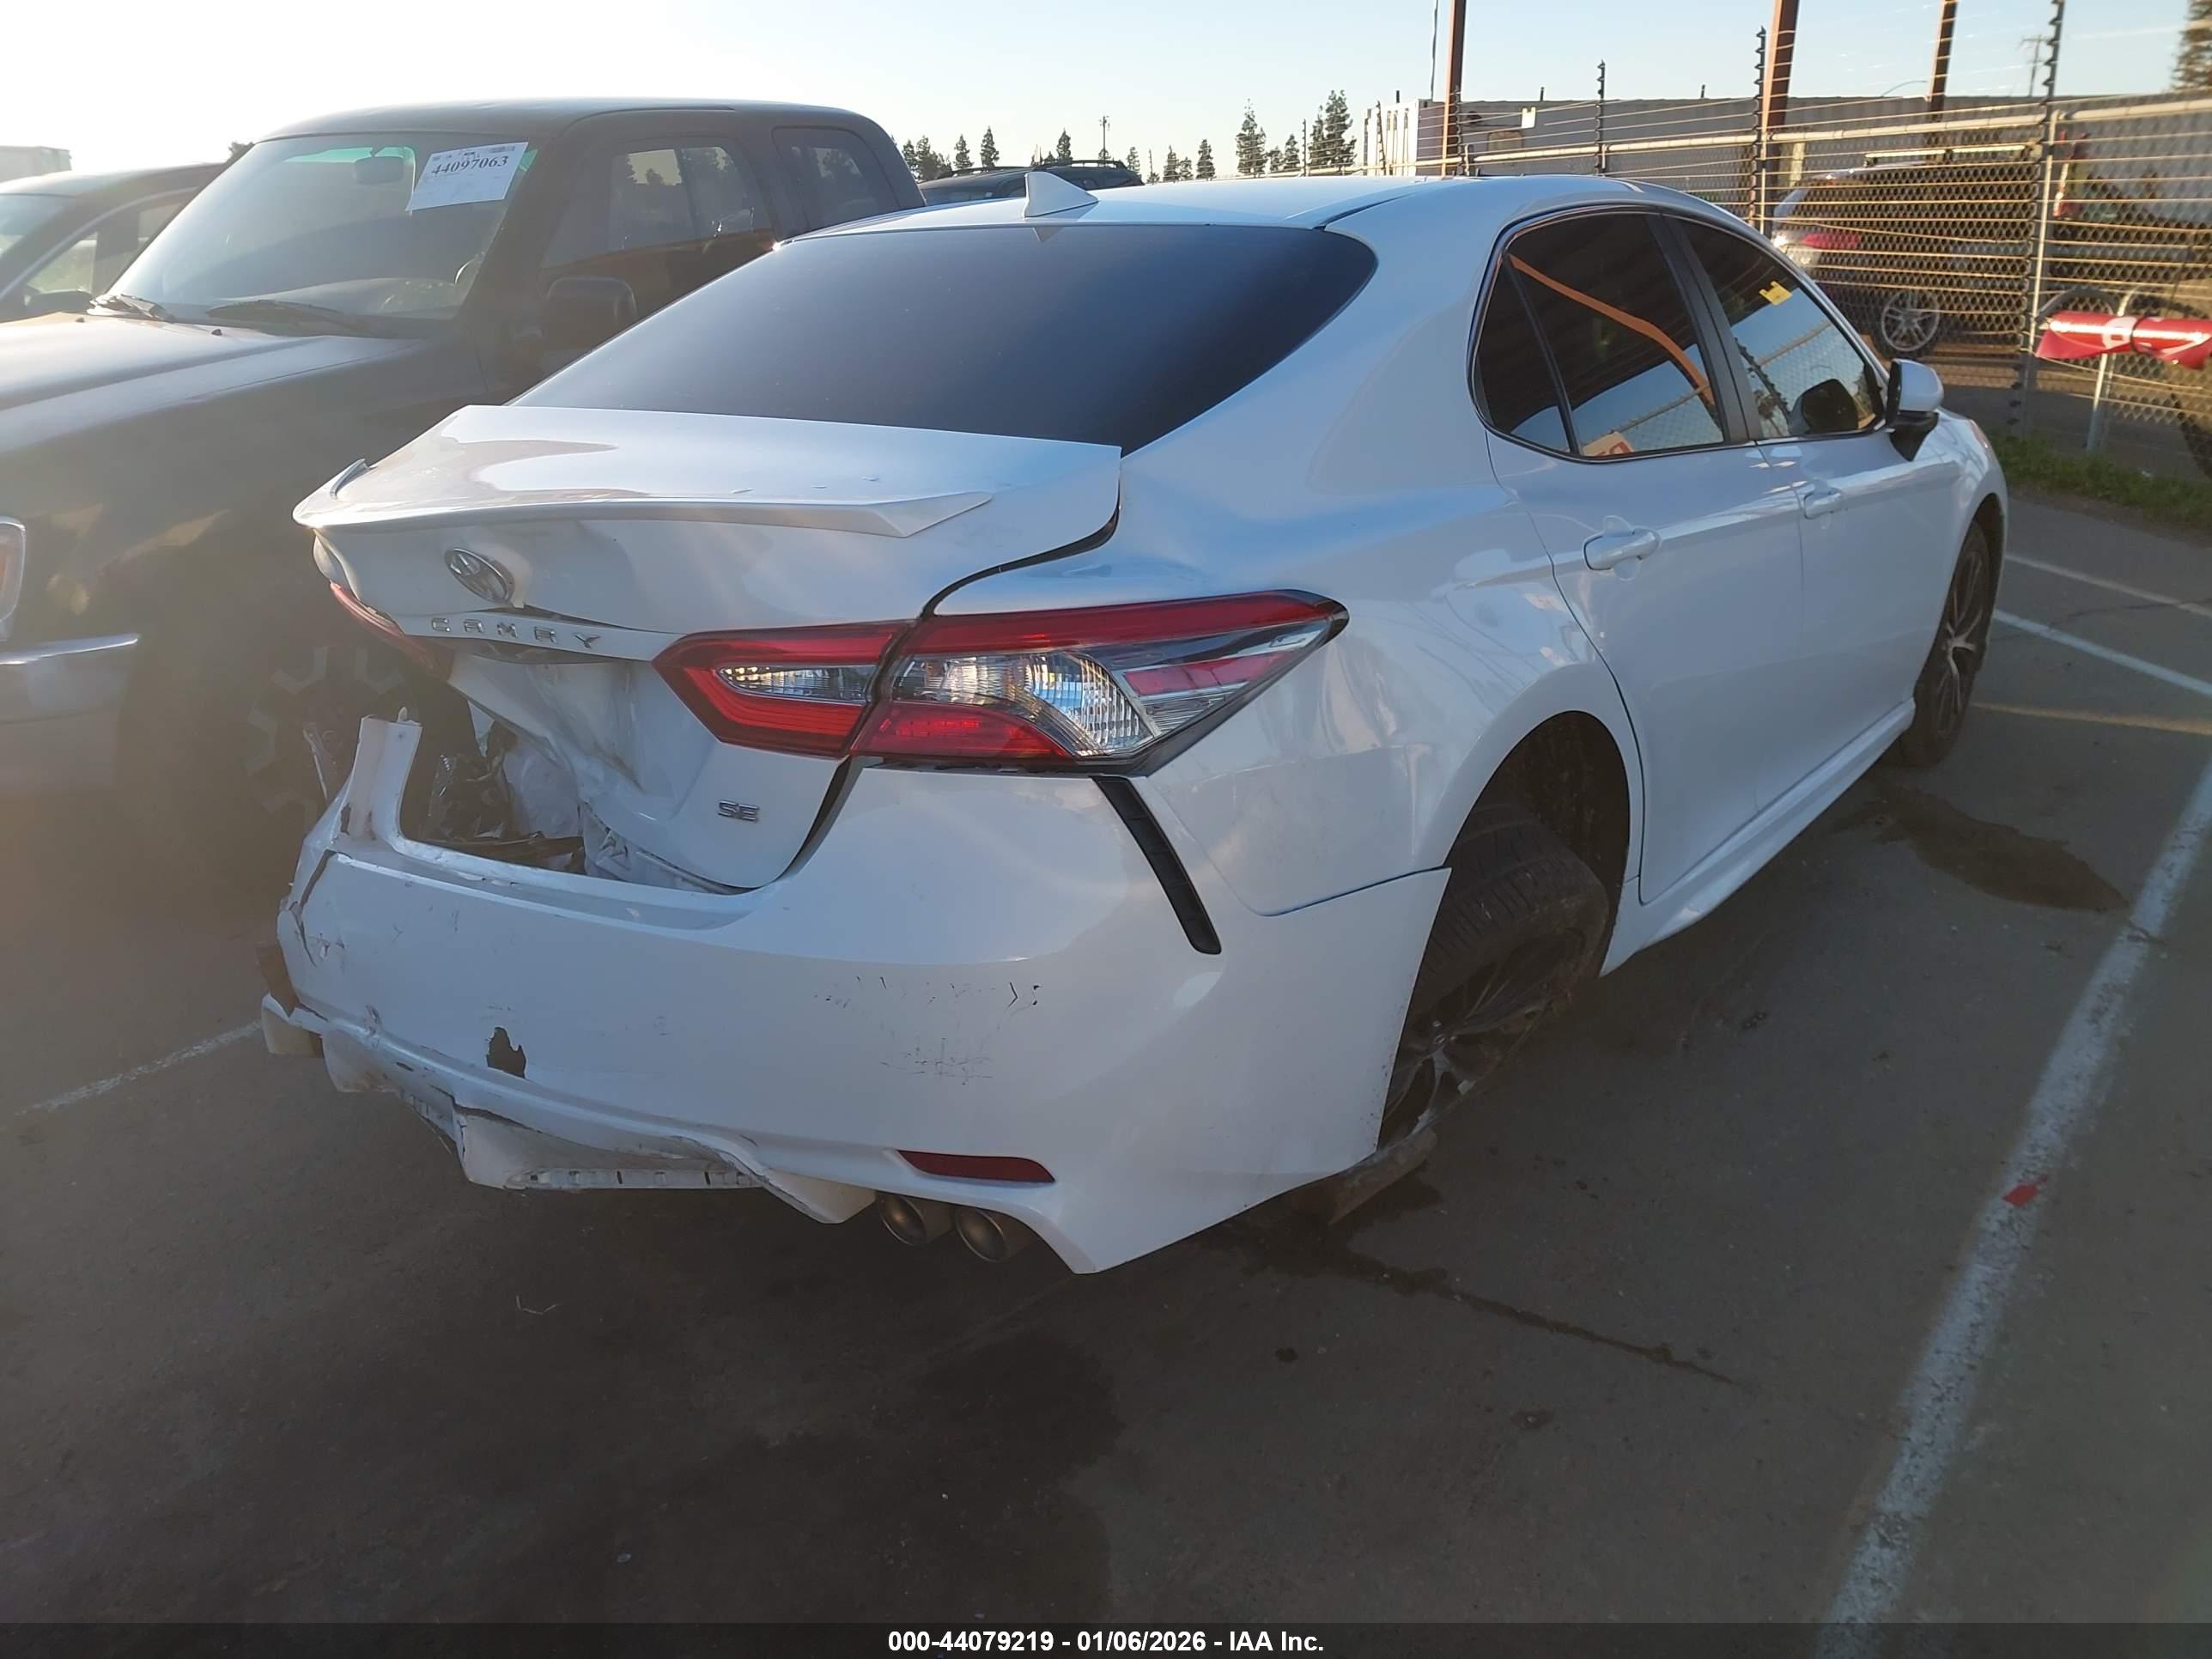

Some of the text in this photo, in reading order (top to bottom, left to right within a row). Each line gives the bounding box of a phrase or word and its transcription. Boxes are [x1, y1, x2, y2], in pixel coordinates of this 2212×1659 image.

[431, 155, 509, 175] 44097063
[431, 617, 601, 649] CAMRY
[718, 799, 760, 822] SE
